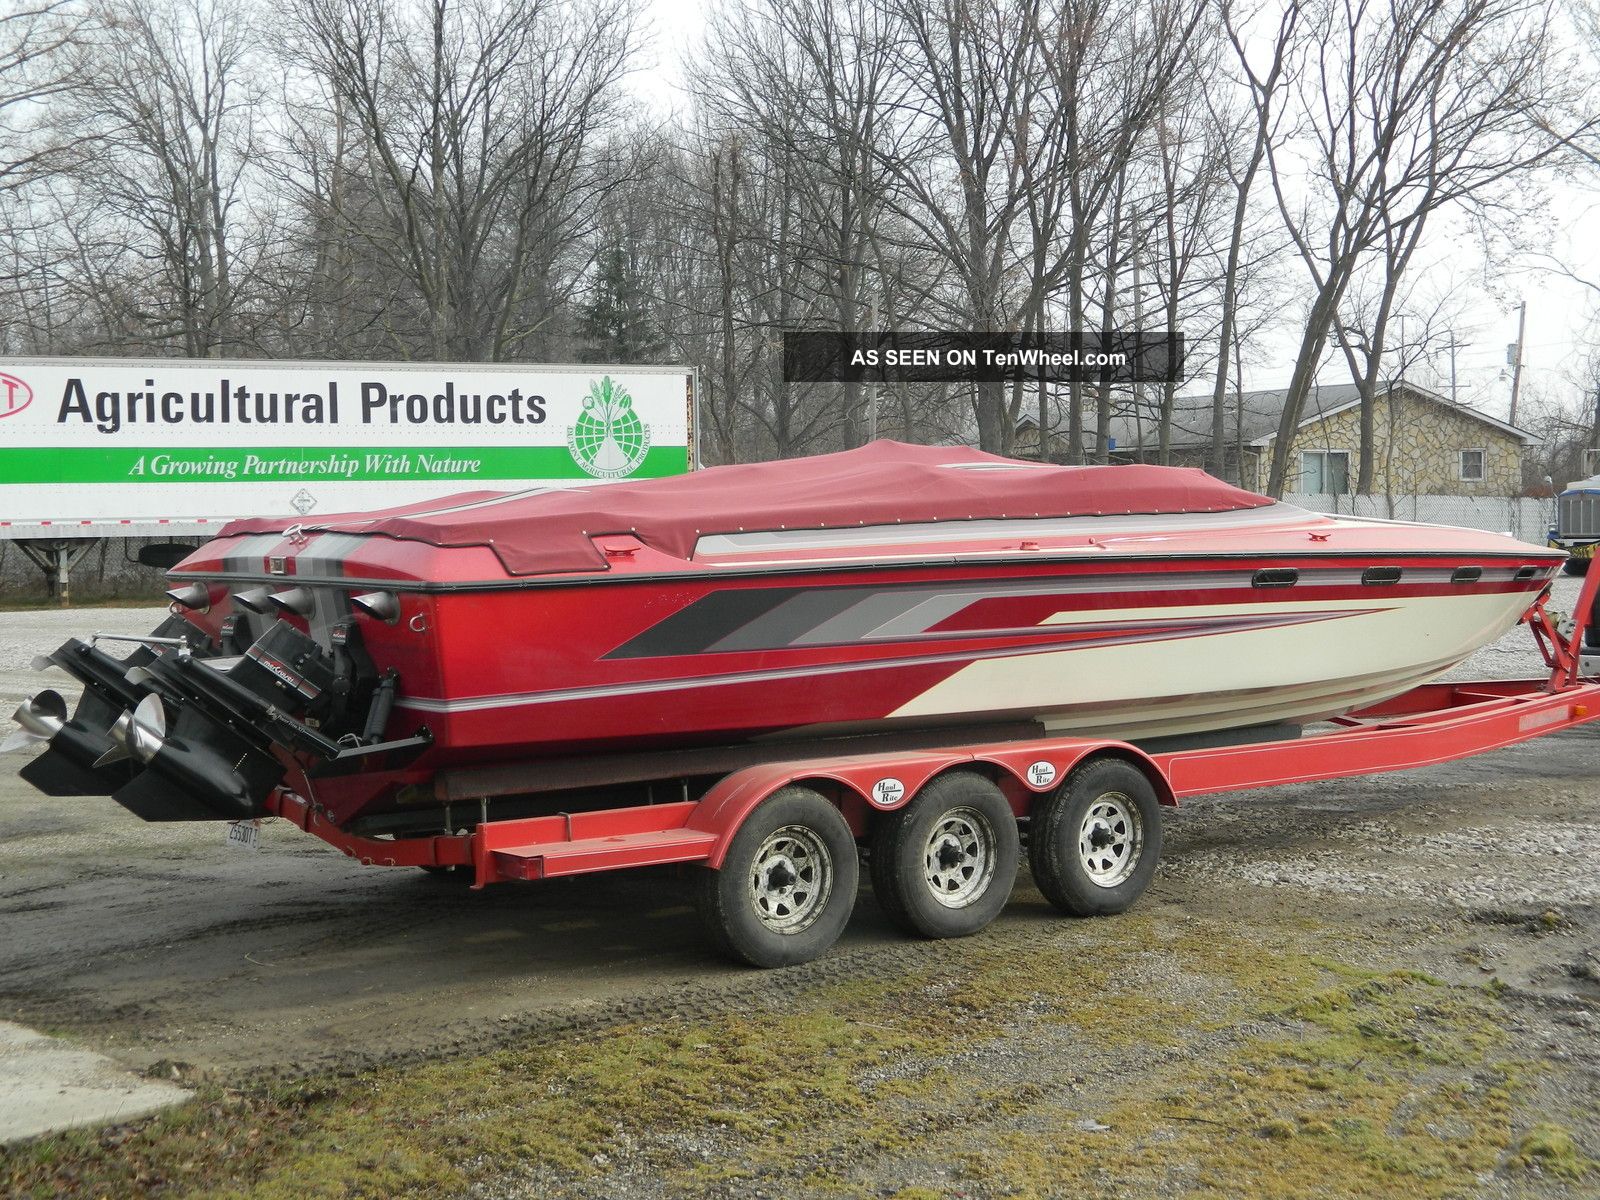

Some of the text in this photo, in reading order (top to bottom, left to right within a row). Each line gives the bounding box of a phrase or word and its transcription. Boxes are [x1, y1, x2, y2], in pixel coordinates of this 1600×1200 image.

[57, 378, 547, 434] Agricultural Products
[128, 453, 481, 479] A Growing Partnership With Nature
